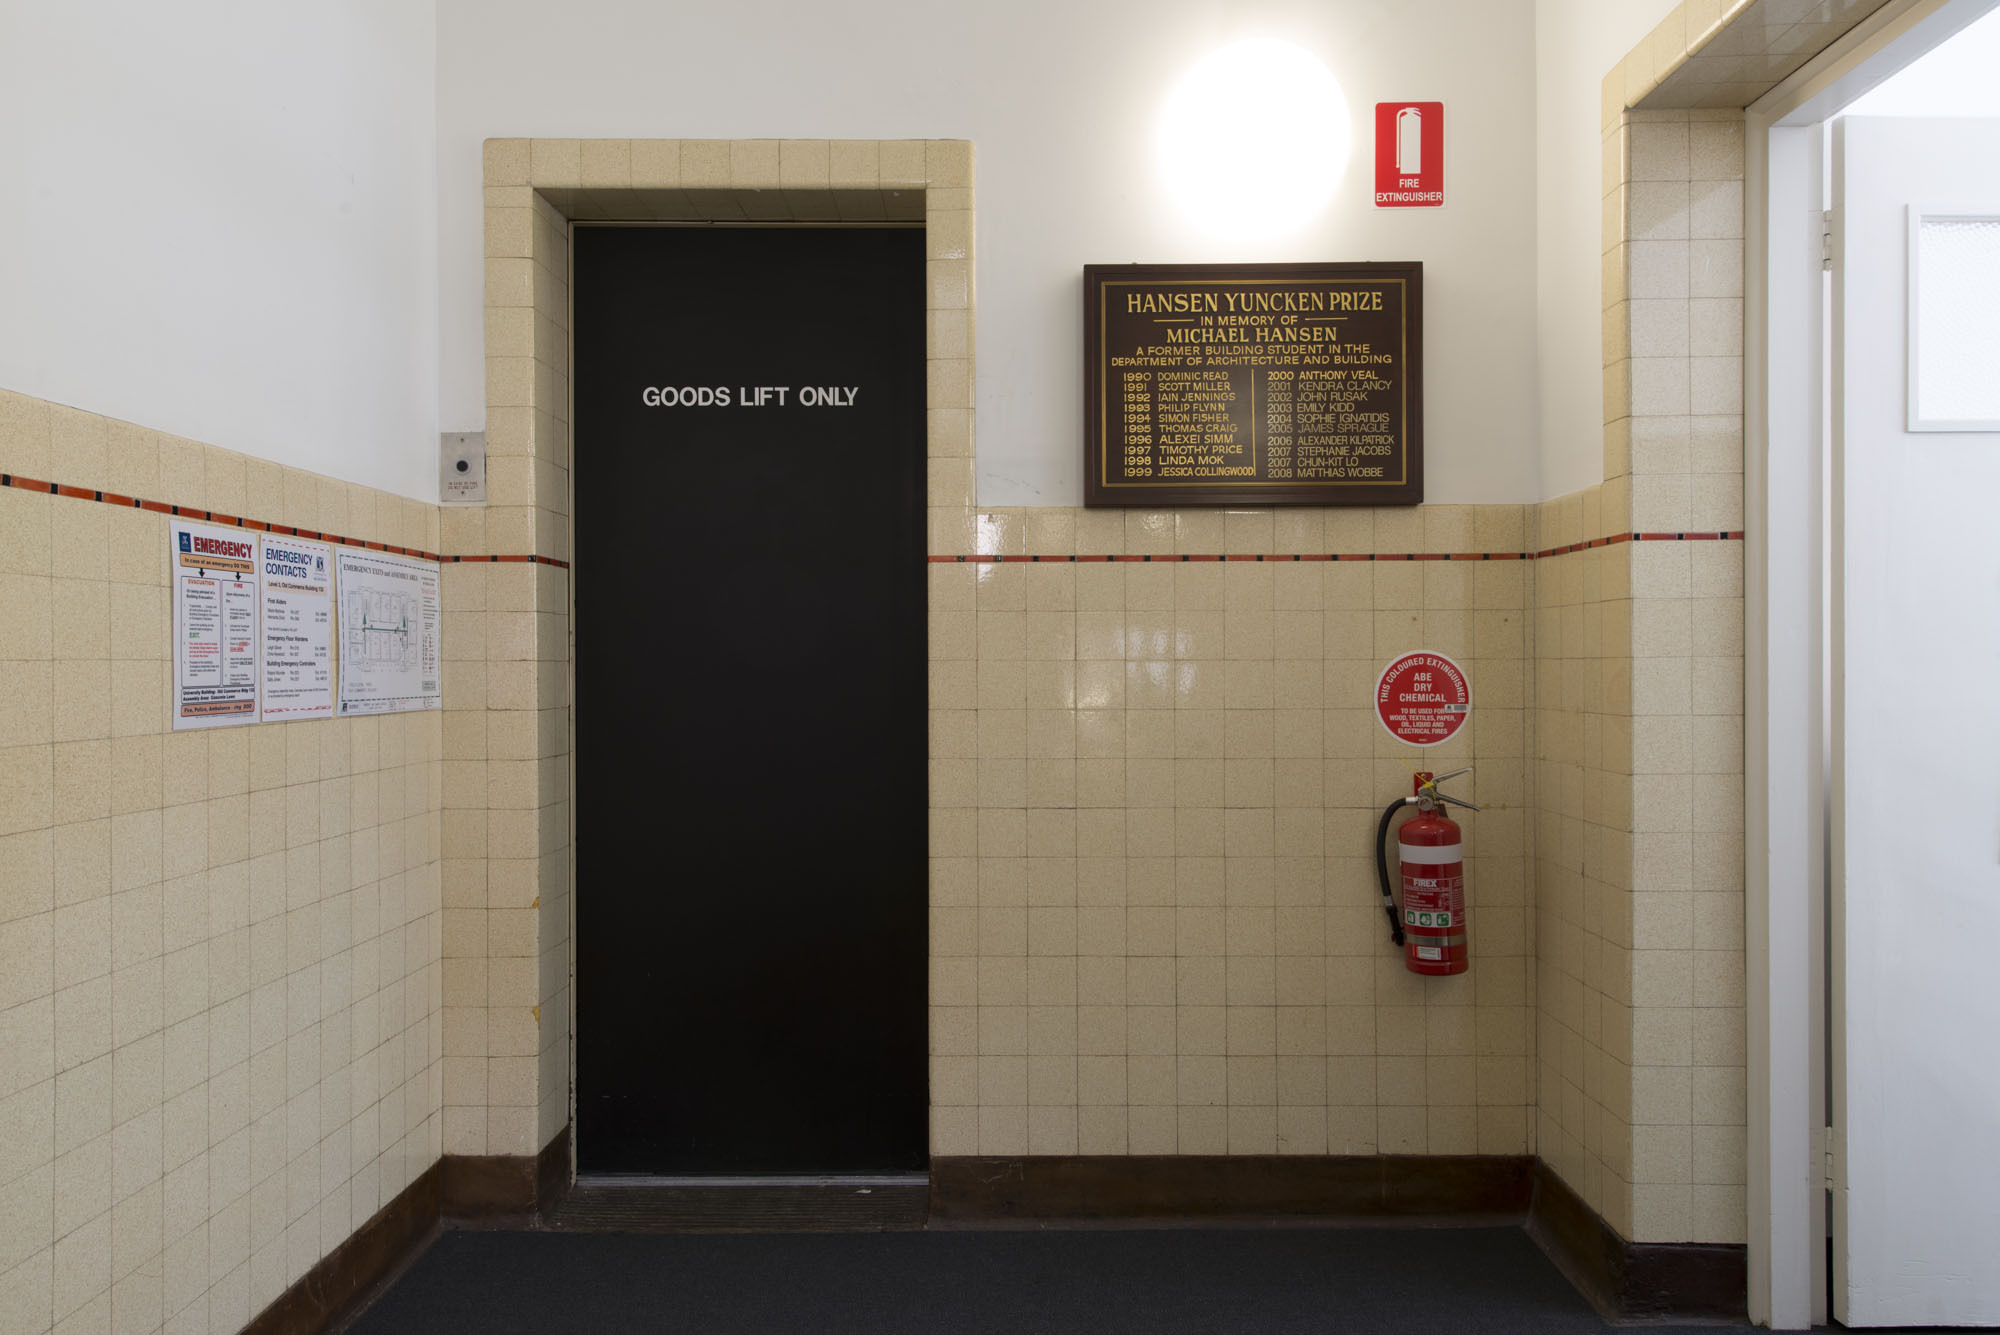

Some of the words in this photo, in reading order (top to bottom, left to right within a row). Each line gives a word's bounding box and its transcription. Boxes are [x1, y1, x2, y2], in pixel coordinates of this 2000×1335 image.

[1400, 179, 1420, 188] FIRE
[1376, 192, 1442, 202] EXTINGUISHER
[1127, 293, 1218, 313] HANSEN
[1224, 292, 1323, 311] YUNCKEN
[1329, 292, 1383, 311] PRIZE
[1201, 316, 1211, 326] IN
[1218, 316, 1274, 326] MEMORY
[1280, 315, 1298, 325] OF
[1167, 328, 1249, 343] MICHAEL
[1256, 327, 1337, 342] HANSEN
[1136, 347, 1144, 356] A
[1148, 346, 1200, 356] FORMER
[1205, 345, 1264, 355] BUILDING
[1267, 345, 1323, 354] STUDENT
[1329, 345, 1341, 354] IN
[1344, 344, 1370, 353] THE
[1111, 357, 1182, 367] DEPARTMENT
[1186, 356, 1202, 366] OF
[1207, 356, 1299, 366] ARCHITECTURE
[1303, 355, 1330, 364] AND
[1334, 355, 1392, 364] BUILDING
[1123, 373, 1152, 381] 1990
[1158, 372, 1201, 381] DOMINIC
[1203, 372, 1229, 380] READ
[1268, 372, 1294, 380] 2000
[1299, 371, 1348, 380] ANTHONY
[1351, 371, 1379, 379] VEAL
[1124, 383, 1146, 392] 1991
[1158, 383, 1191, 391] SCOTT
[1193, 382, 1230, 391] MILLER
[1268, 382, 1291, 391] 2001
[1299, 381, 1344, 391] KENDRA
[1347, 380, 1392, 390] CLANCY
[643, 387, 731, 406] GOODS
[740, 387, 789, 406] LIFT
[800, 387, 858, 406] ONLY
[1124, 393, 1150, 402] 1992
[1158, 393, 1179, 401] IAIN
[1181, 393, 1236, 401] JENNINGS
[1267, 392, 1292, 401] 2002
[1297, 392, 1326, 401] JOHN
[1330, 392, 1368, 401] RUSAK
[1124, 404, 1151, 412] 1993
[1158, 403, 1190, 412] PHILIP
[1193, 403, 1225, 411] FLYNN
[1267, 403, 1292, 413] 2003
[1297, 403, 1325, 412] EMILY
[1330, 403, 1354, 412] KIDD
[1124, 414, 1151, 423] 1994
[1158, 414, 1190, 422] SIMON
[1193, 414, 1229, 422] FISHER
[1267, 414, 1292, 424] 2004
[1297, 414, 1336, 423] SOPHIE
[1124, 425, 1151, 433] 1995
[1159, 424, 1203, 432] THOMAS
[1206, 424, 1238, 432] CRAIG
[1268, 424, 1293, 433] 2005
[1298, 424, 1334, 433] JAMES
[1337, 423, 1389, 433] SPRAGUE
[1125, 436, 1152, 444] 1996
[1160, 435, 1200, 444] ALEXEI
[1204, 435, 1233, 443] SIMM
[1268, 436, 1292, 446] 2006
[1298, 436, 1348, 445] ALEXANDER
[1350, 435, 1394, 445] KILPATRICK
[1124, 446, 1151, 455] 1997
[1159, 446, 1208, 454] TIMOTHY
[1212, 445, 1243, 454] PRICE
[1268, 447, 1291, 456] 2007
[1297, 446, 1350, 456] STEPHANIE
[1352, 446, 1391, 455] JACOBS
[1125, 457, 1151, 465] 1998
[1159, 456, 1195, 465] LINDA
[1198, 456, 1224, 464] MOK
[1268, 458, 1291, 467] 2007
[1297, 457, 1344, 467] CHUN-KIT
[1346, 457, 1358, 466] LO
[1125, 468, 1152, 477] 1999
[1158, 467, 1193, 476] JESSICA
[1195, 466, 1254, 476] COLLINGWOOD
[1268, 469, 1292, 478] 2008
[1298, 467, 1345, 478] MATTHIAS
[1347, 467, 1384, 477] WOBBE
[194, 536, 252, 558] EMERGENCY
[266, 548, 312, 565] EMERGENCY
[266, 563, 307, 578] CONTACTS
[344, 564, 371, 574] EMERGENCY
[1380, 684, 1390, 703] THIS
[1386, 657, 1424, 682] COLOURED
[1427, 658, 1465, 702] EXTINGUISHER
[1414, 673, 1432, 681] ABE
[1414, 683, 1432, 691] DRY
[1400, 694, 1446, 702] CHEMICAL
